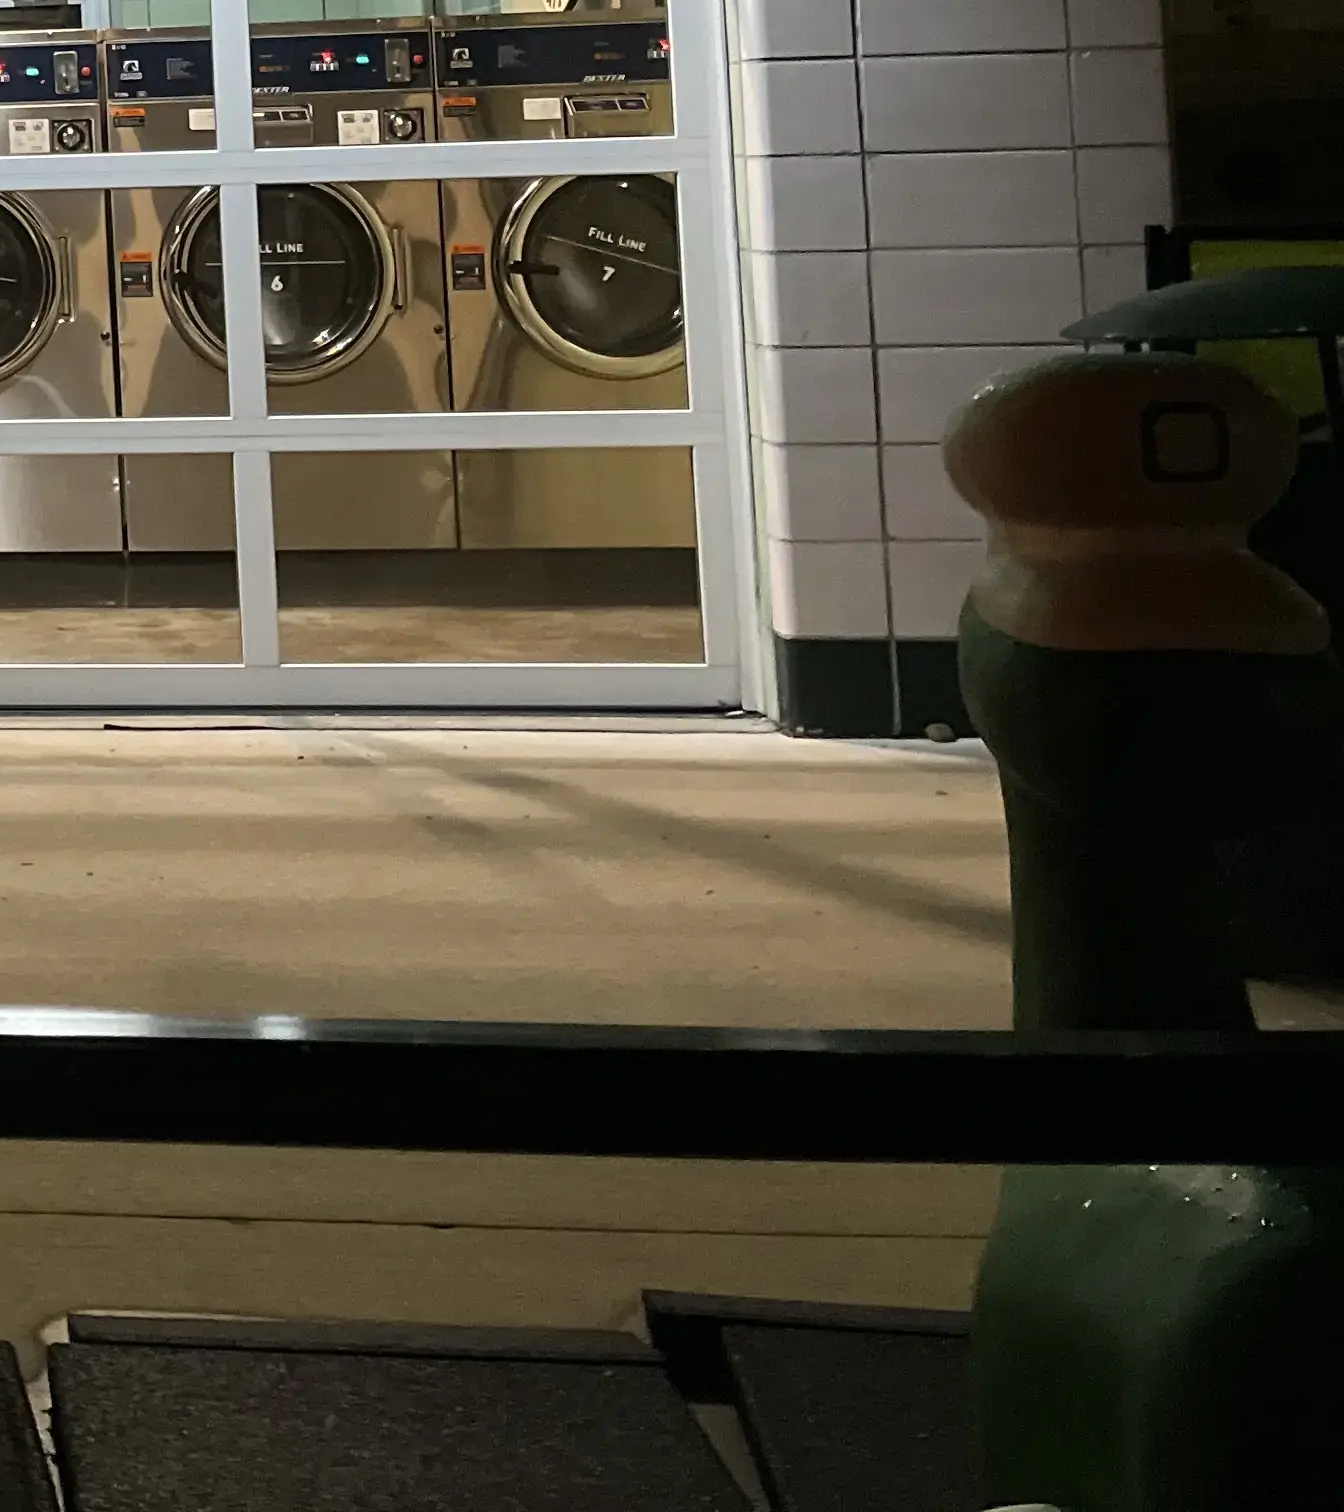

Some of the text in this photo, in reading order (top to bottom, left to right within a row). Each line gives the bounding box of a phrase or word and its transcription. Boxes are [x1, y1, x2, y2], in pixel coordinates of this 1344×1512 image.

[276, 241, 304, 254] LINE
[588, 226, 647, 253] FILL LINE
[602, 265, 616, 282] 7
[271, 274, 284, 292] 6
